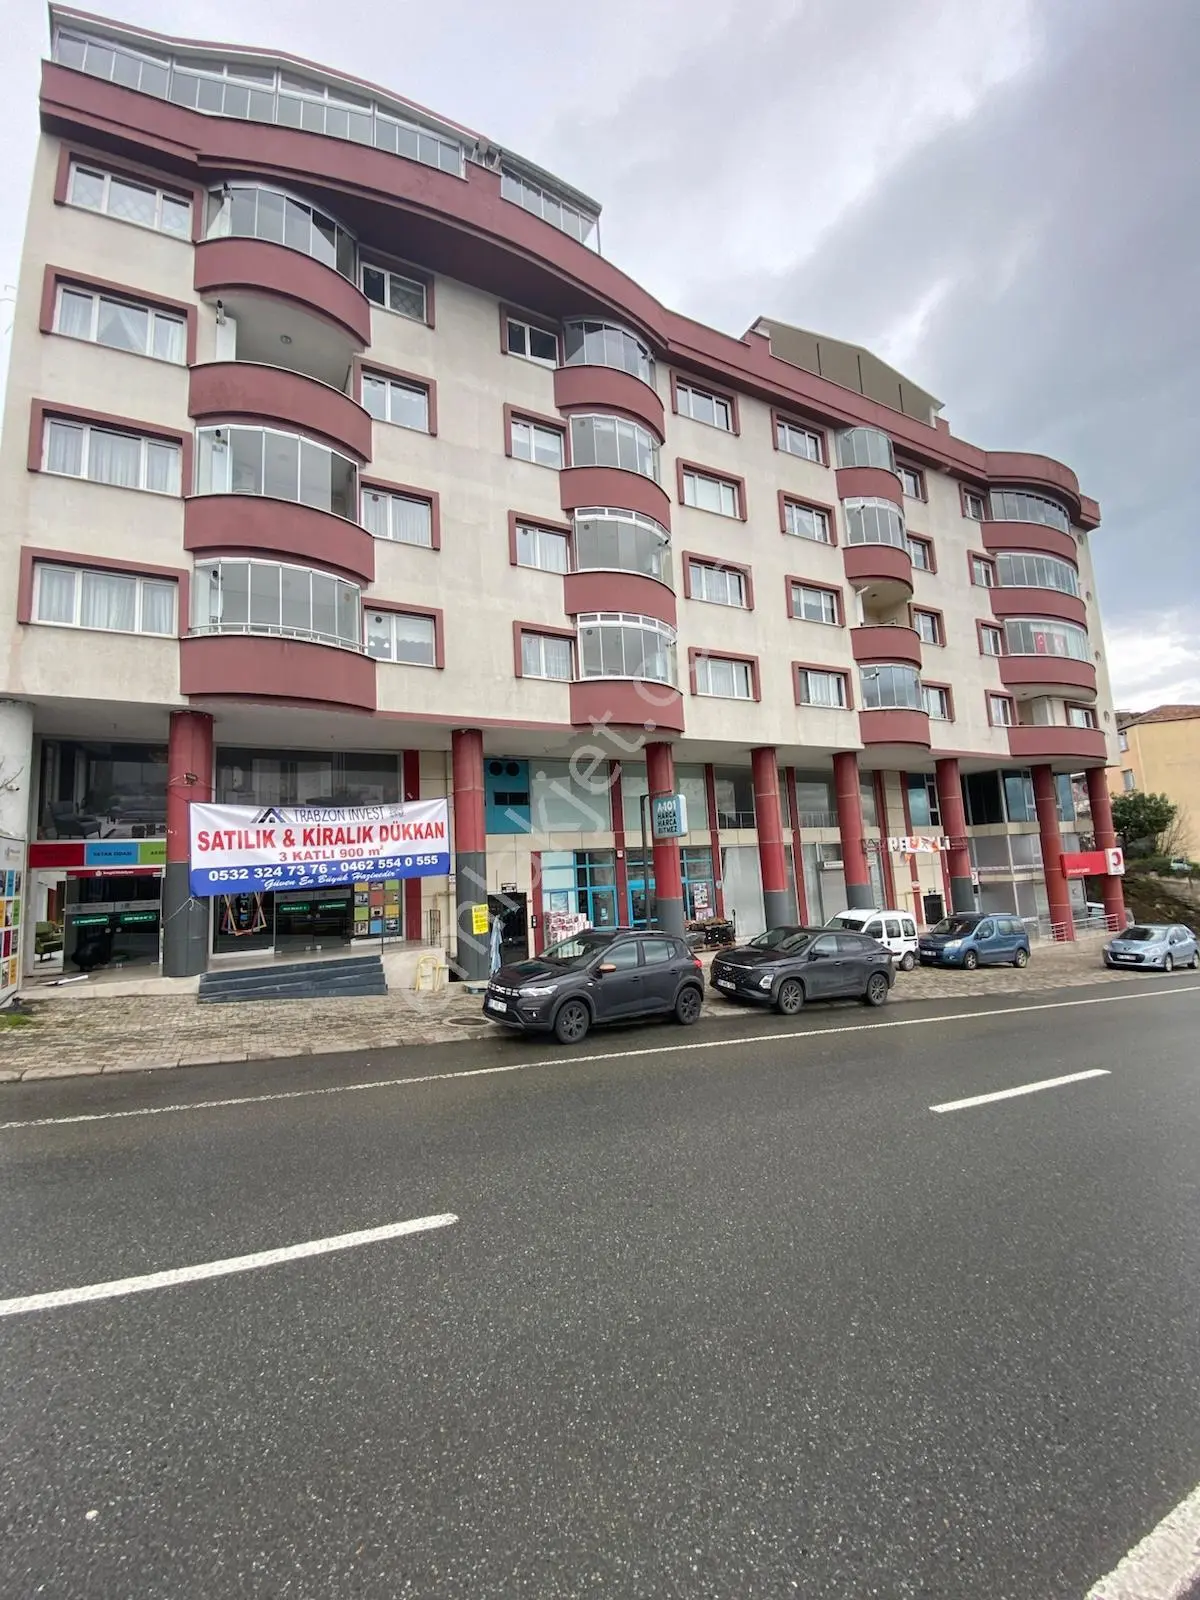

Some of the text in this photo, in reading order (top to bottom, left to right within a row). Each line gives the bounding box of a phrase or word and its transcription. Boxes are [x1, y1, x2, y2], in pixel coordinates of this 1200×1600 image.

[294, 808, 346, 822] TRABZON
[348, 806, 385, 820] INVEST
[197, 821, 445, 852] SATILIK & KİRALIK DÜKKAN
[279, 852, 287, 862] 3
[293, 850, 335, 861] KATLI
[340, 848, 364, 858] 900
[208, 868, 249, 881] 0532
[254, 866, 283, 878] 324
[287, 865, 306, 876] 73
[310, 863, 328, 874] 76
[340, 861, 375, 872] 0462
[378, 858, 401, 869] 554
[405, 857, 412, 866] 0
[416, 855, 438, 865] 555
[299, 876, 314, 886] En
[318, 873, 348, 884] Büyük
